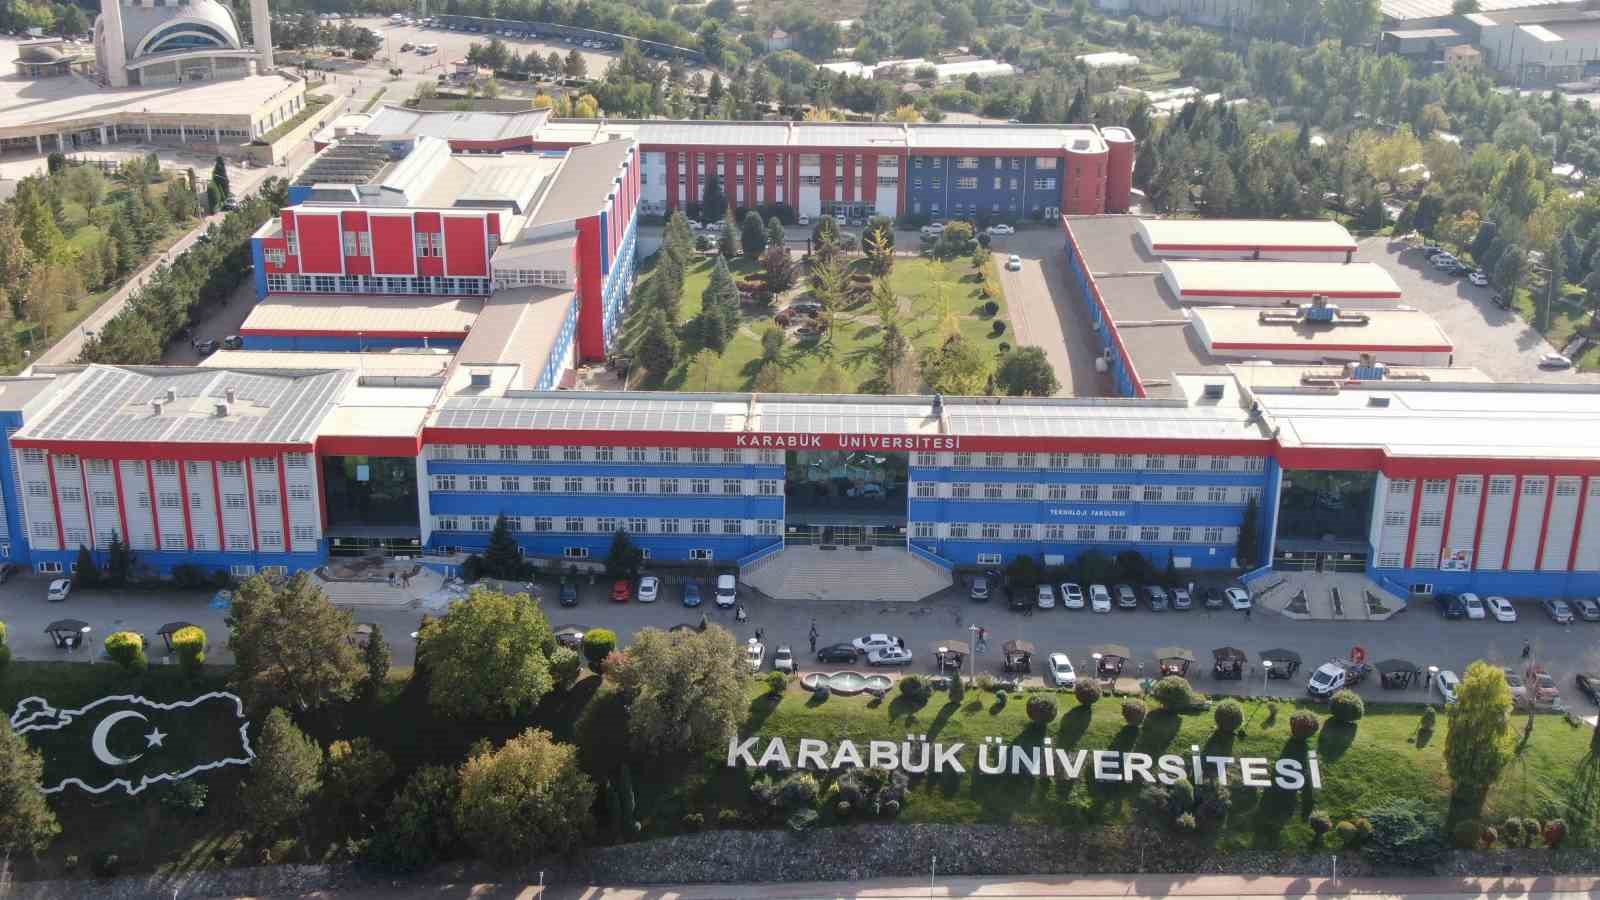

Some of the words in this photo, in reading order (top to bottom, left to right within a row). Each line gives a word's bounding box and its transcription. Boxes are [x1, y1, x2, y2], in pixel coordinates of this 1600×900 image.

[736, 433, 821, 447] KARABÜK
[839, 433, 960, 449] ÜNİVERSİTESİ
[726, 734, 966, 774] KARABÜK
[978, 736, 1323, 789] ÜNİVERSİTESİ
